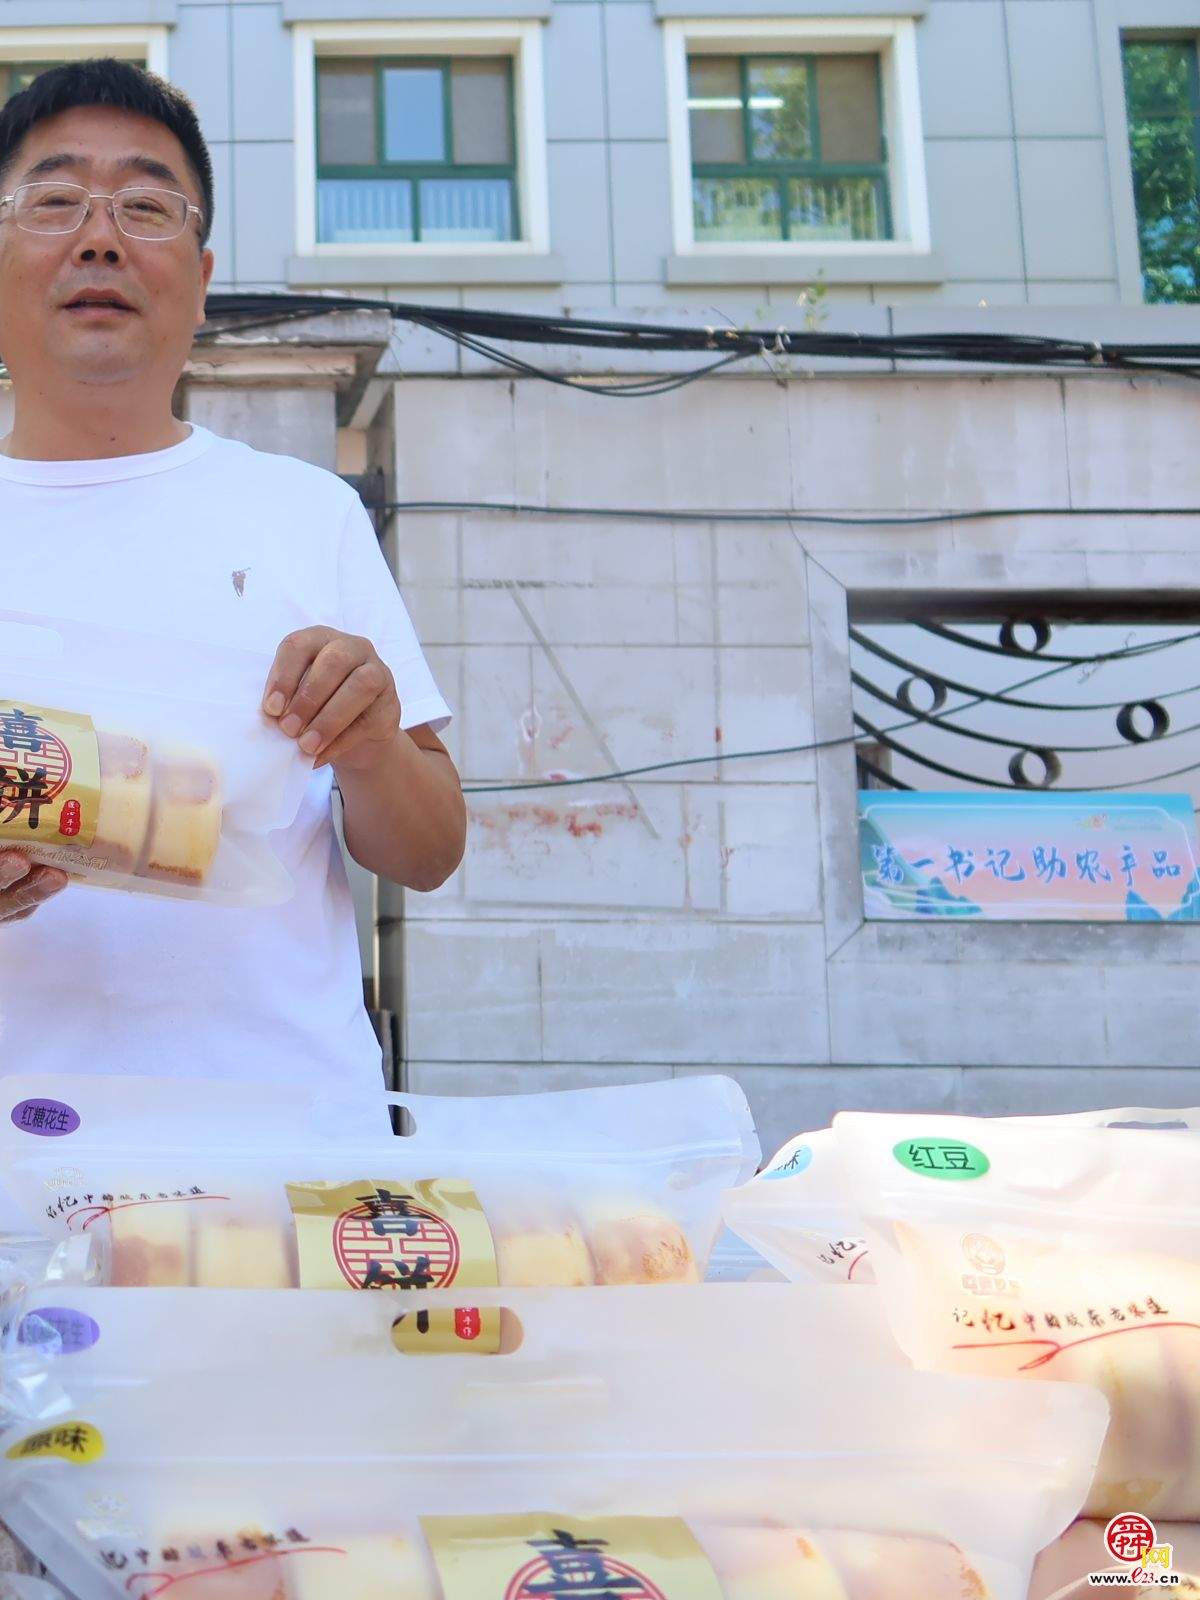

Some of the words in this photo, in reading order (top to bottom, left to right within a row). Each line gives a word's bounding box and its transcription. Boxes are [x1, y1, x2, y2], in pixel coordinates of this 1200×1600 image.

[872, 844, 1181, 887] 第一书记助农产品
[21, 1104, 70, 1132] 红糖花生
[909, 1144, 976, 1171] 红豆
